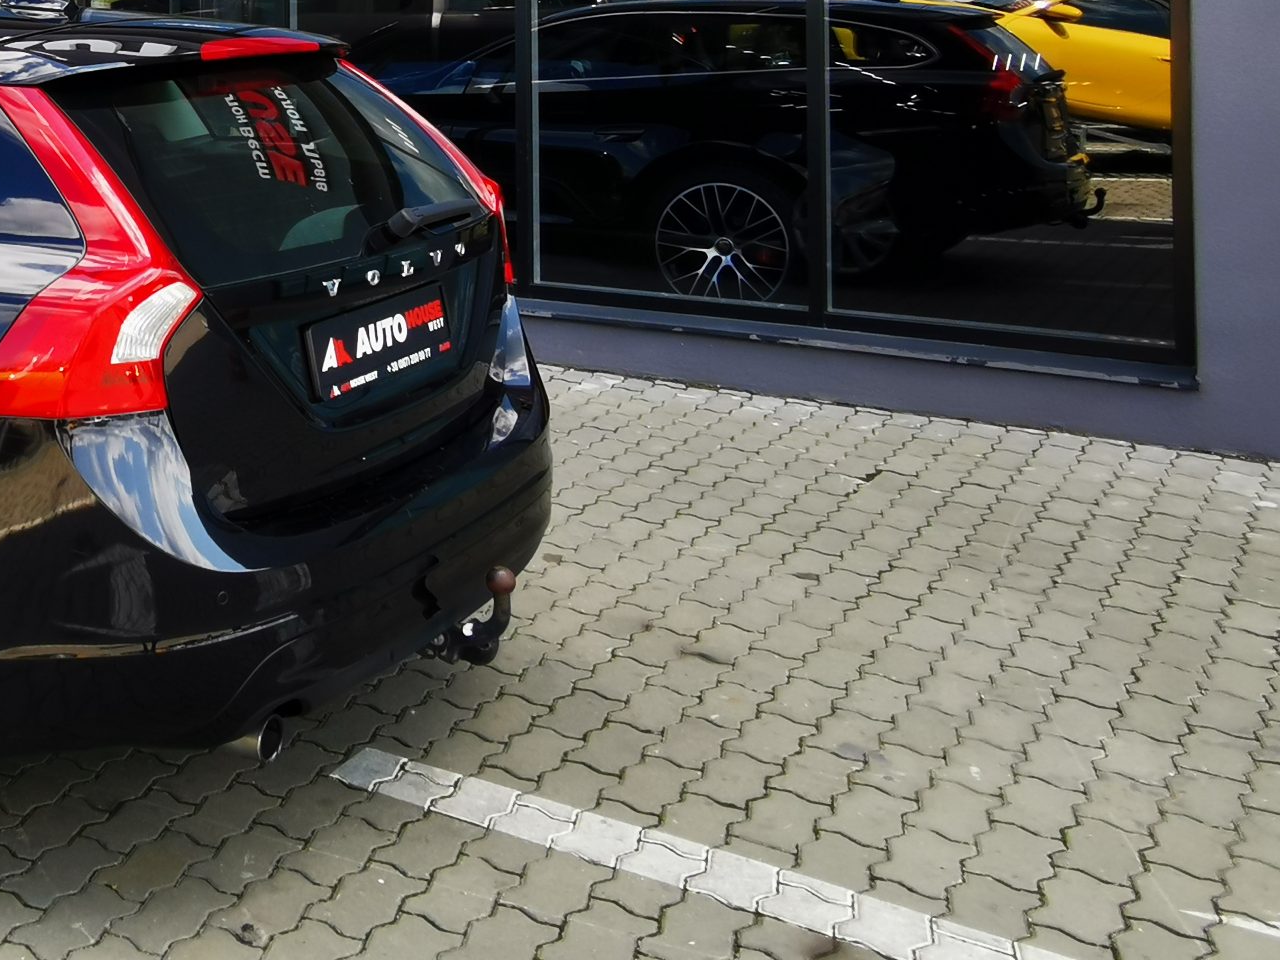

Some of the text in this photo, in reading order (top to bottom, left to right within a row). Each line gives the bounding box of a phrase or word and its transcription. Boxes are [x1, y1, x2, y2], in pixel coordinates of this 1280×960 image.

[322, 242, 466, 297] VOLVO
[356, 313, 408, 359] AUTO
[427, 317, 445, 332] WEST
